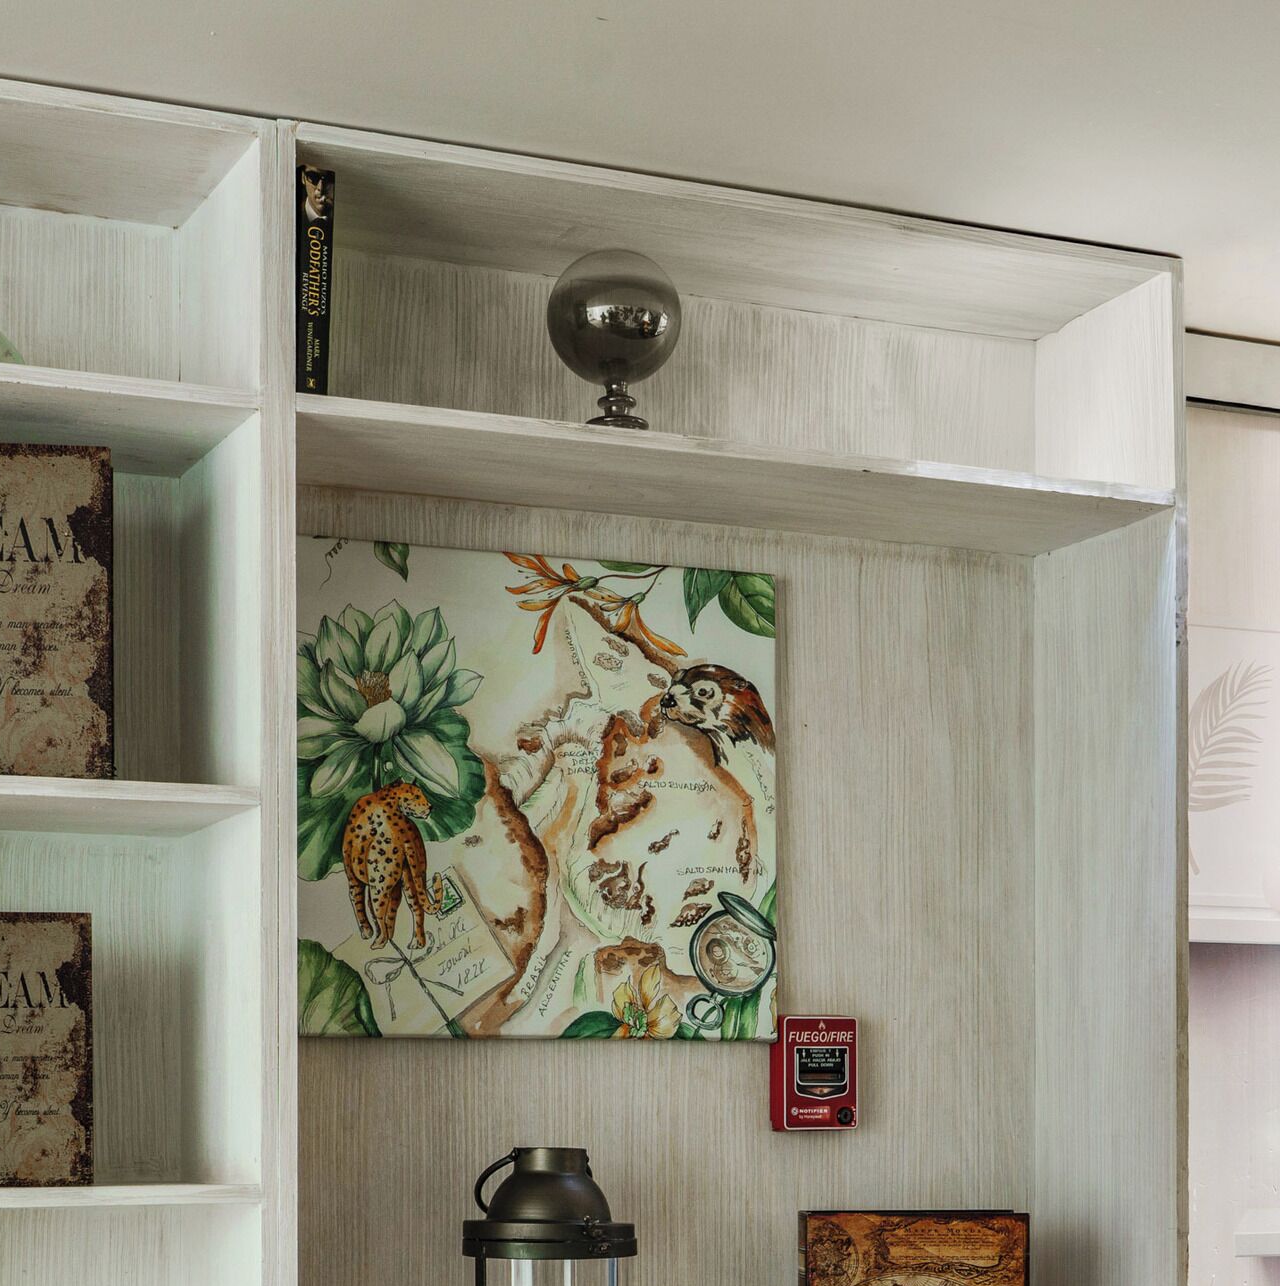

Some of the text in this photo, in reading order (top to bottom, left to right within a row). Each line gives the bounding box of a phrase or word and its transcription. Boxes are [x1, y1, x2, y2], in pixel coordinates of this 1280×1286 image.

[307, 226, 325, 317] GODFATHER'S
[321, 245, 329, 277] MARIO
[301, 272, 309, 311] REVENGE
[0, 1014, 45, 1034] Dream
[789, 1031, 854, 1042] FUEGO/FIRE
